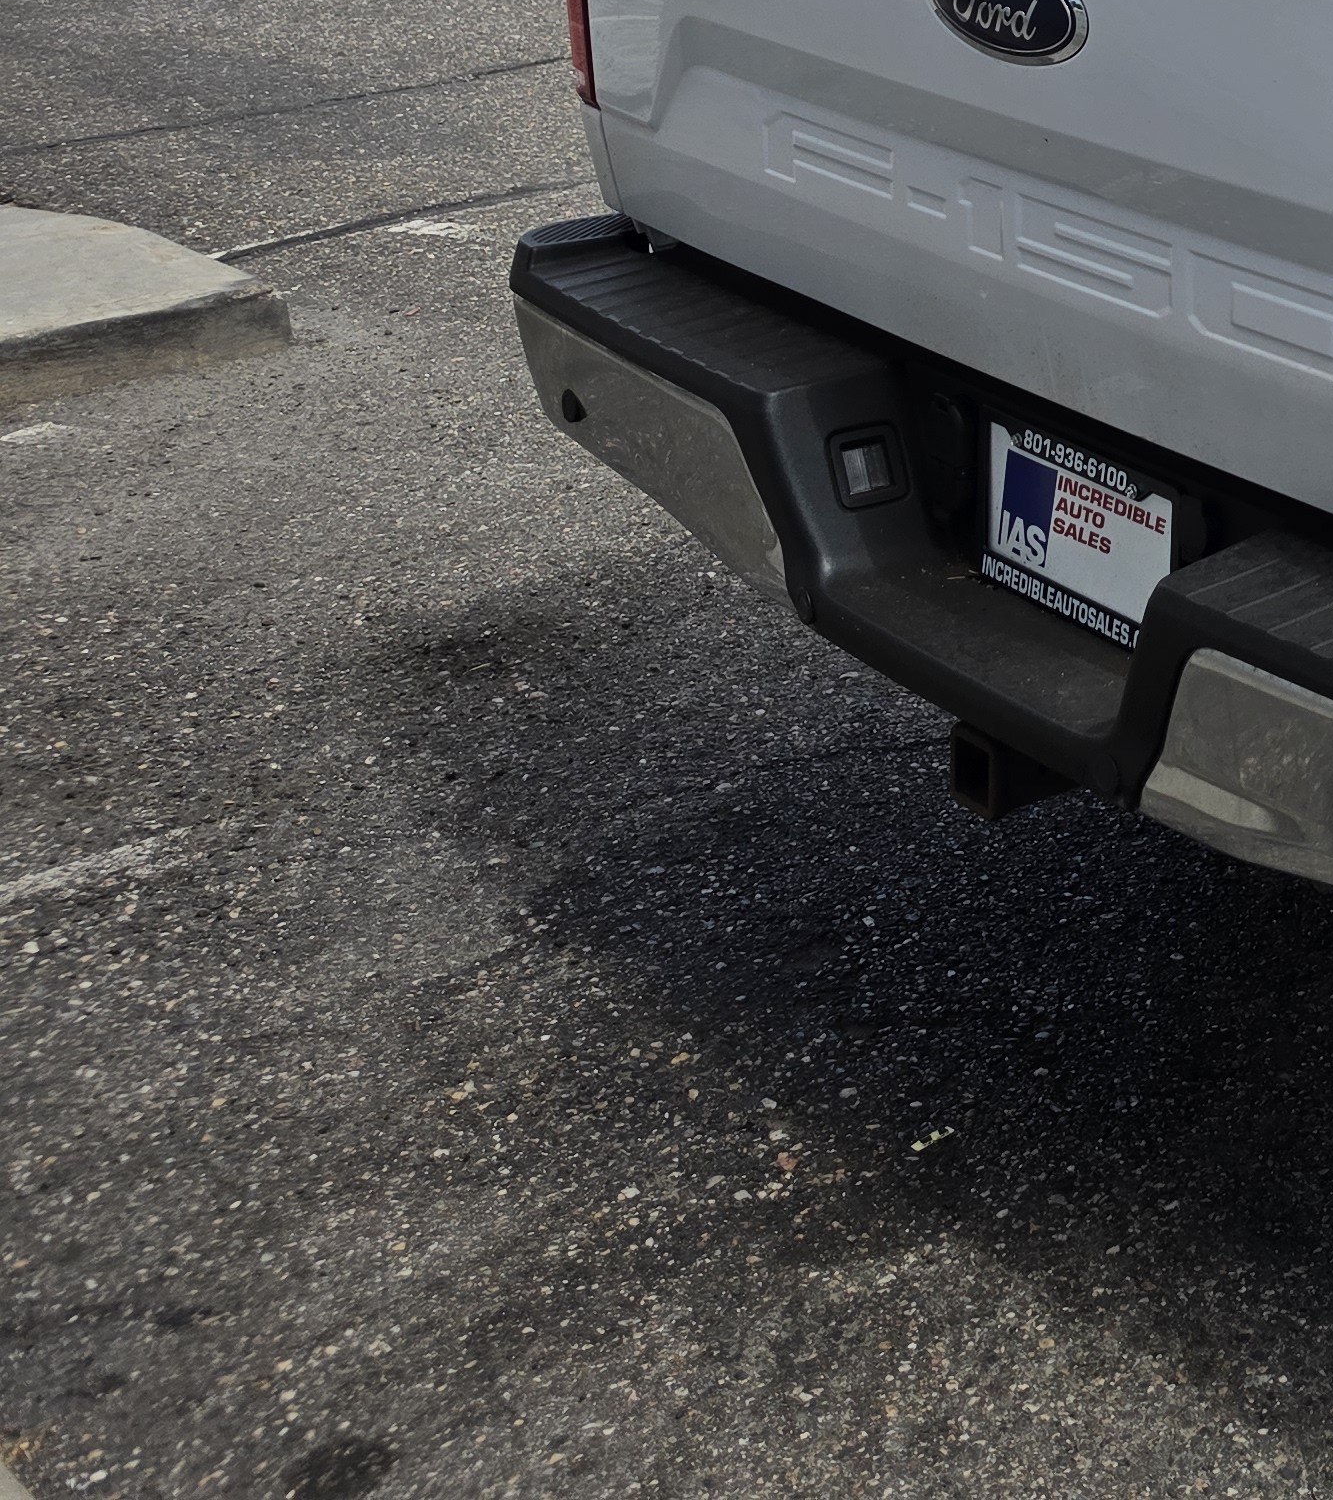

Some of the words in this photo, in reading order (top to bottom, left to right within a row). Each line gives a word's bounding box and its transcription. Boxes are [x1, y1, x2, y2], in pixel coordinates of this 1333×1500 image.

[1023, 429, 1127, 492] 801-936-6100
[1055, 497, 1106, 529] AUTO
[1057, 474, 1167, 535] INCREDIBLE
[998, 510, 1047, 569] IAS
[1052, 517, 1112, 555] SALES
